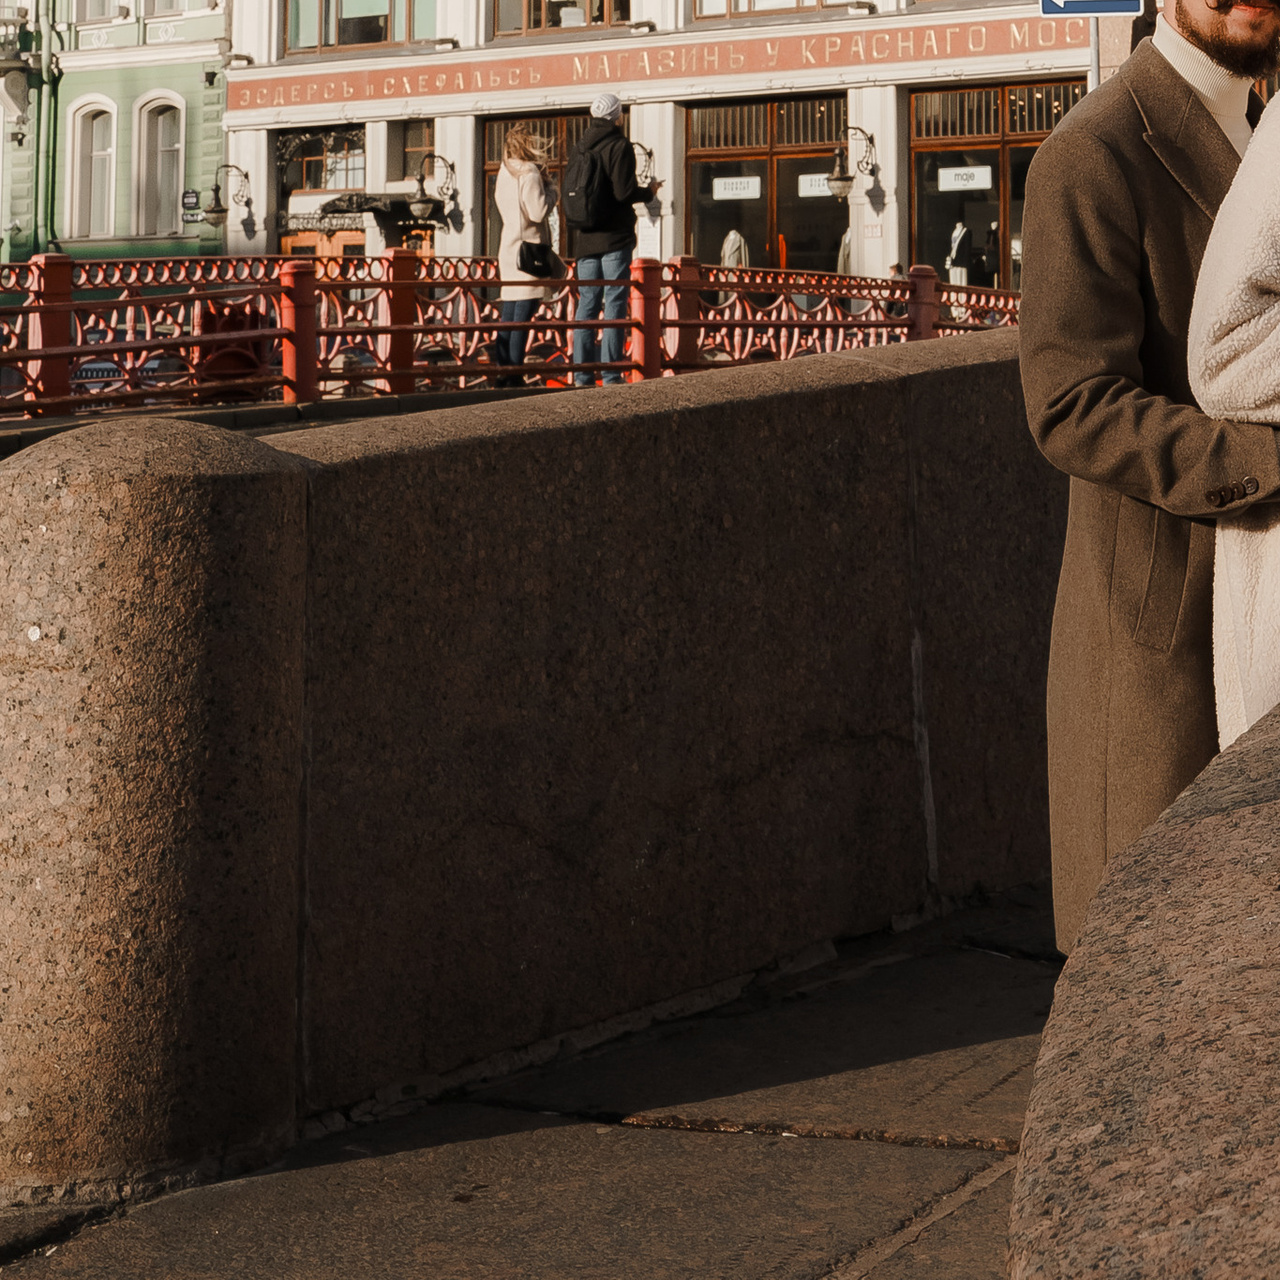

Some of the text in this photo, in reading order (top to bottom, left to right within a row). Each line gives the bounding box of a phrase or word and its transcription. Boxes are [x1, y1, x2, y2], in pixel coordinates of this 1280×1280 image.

[239, 80, 354, 106] ЭСДЕРСЪ
[382, 66, 542, 96] СХЕФАЛЬСЪ
[572, 44, 746, 81] МАГАЗИНЪ
[800, 24, 988, 65] КРАСНАГО
[1009, 17, 1085, 50] МОС
[953, 171, 976, 183] maje
